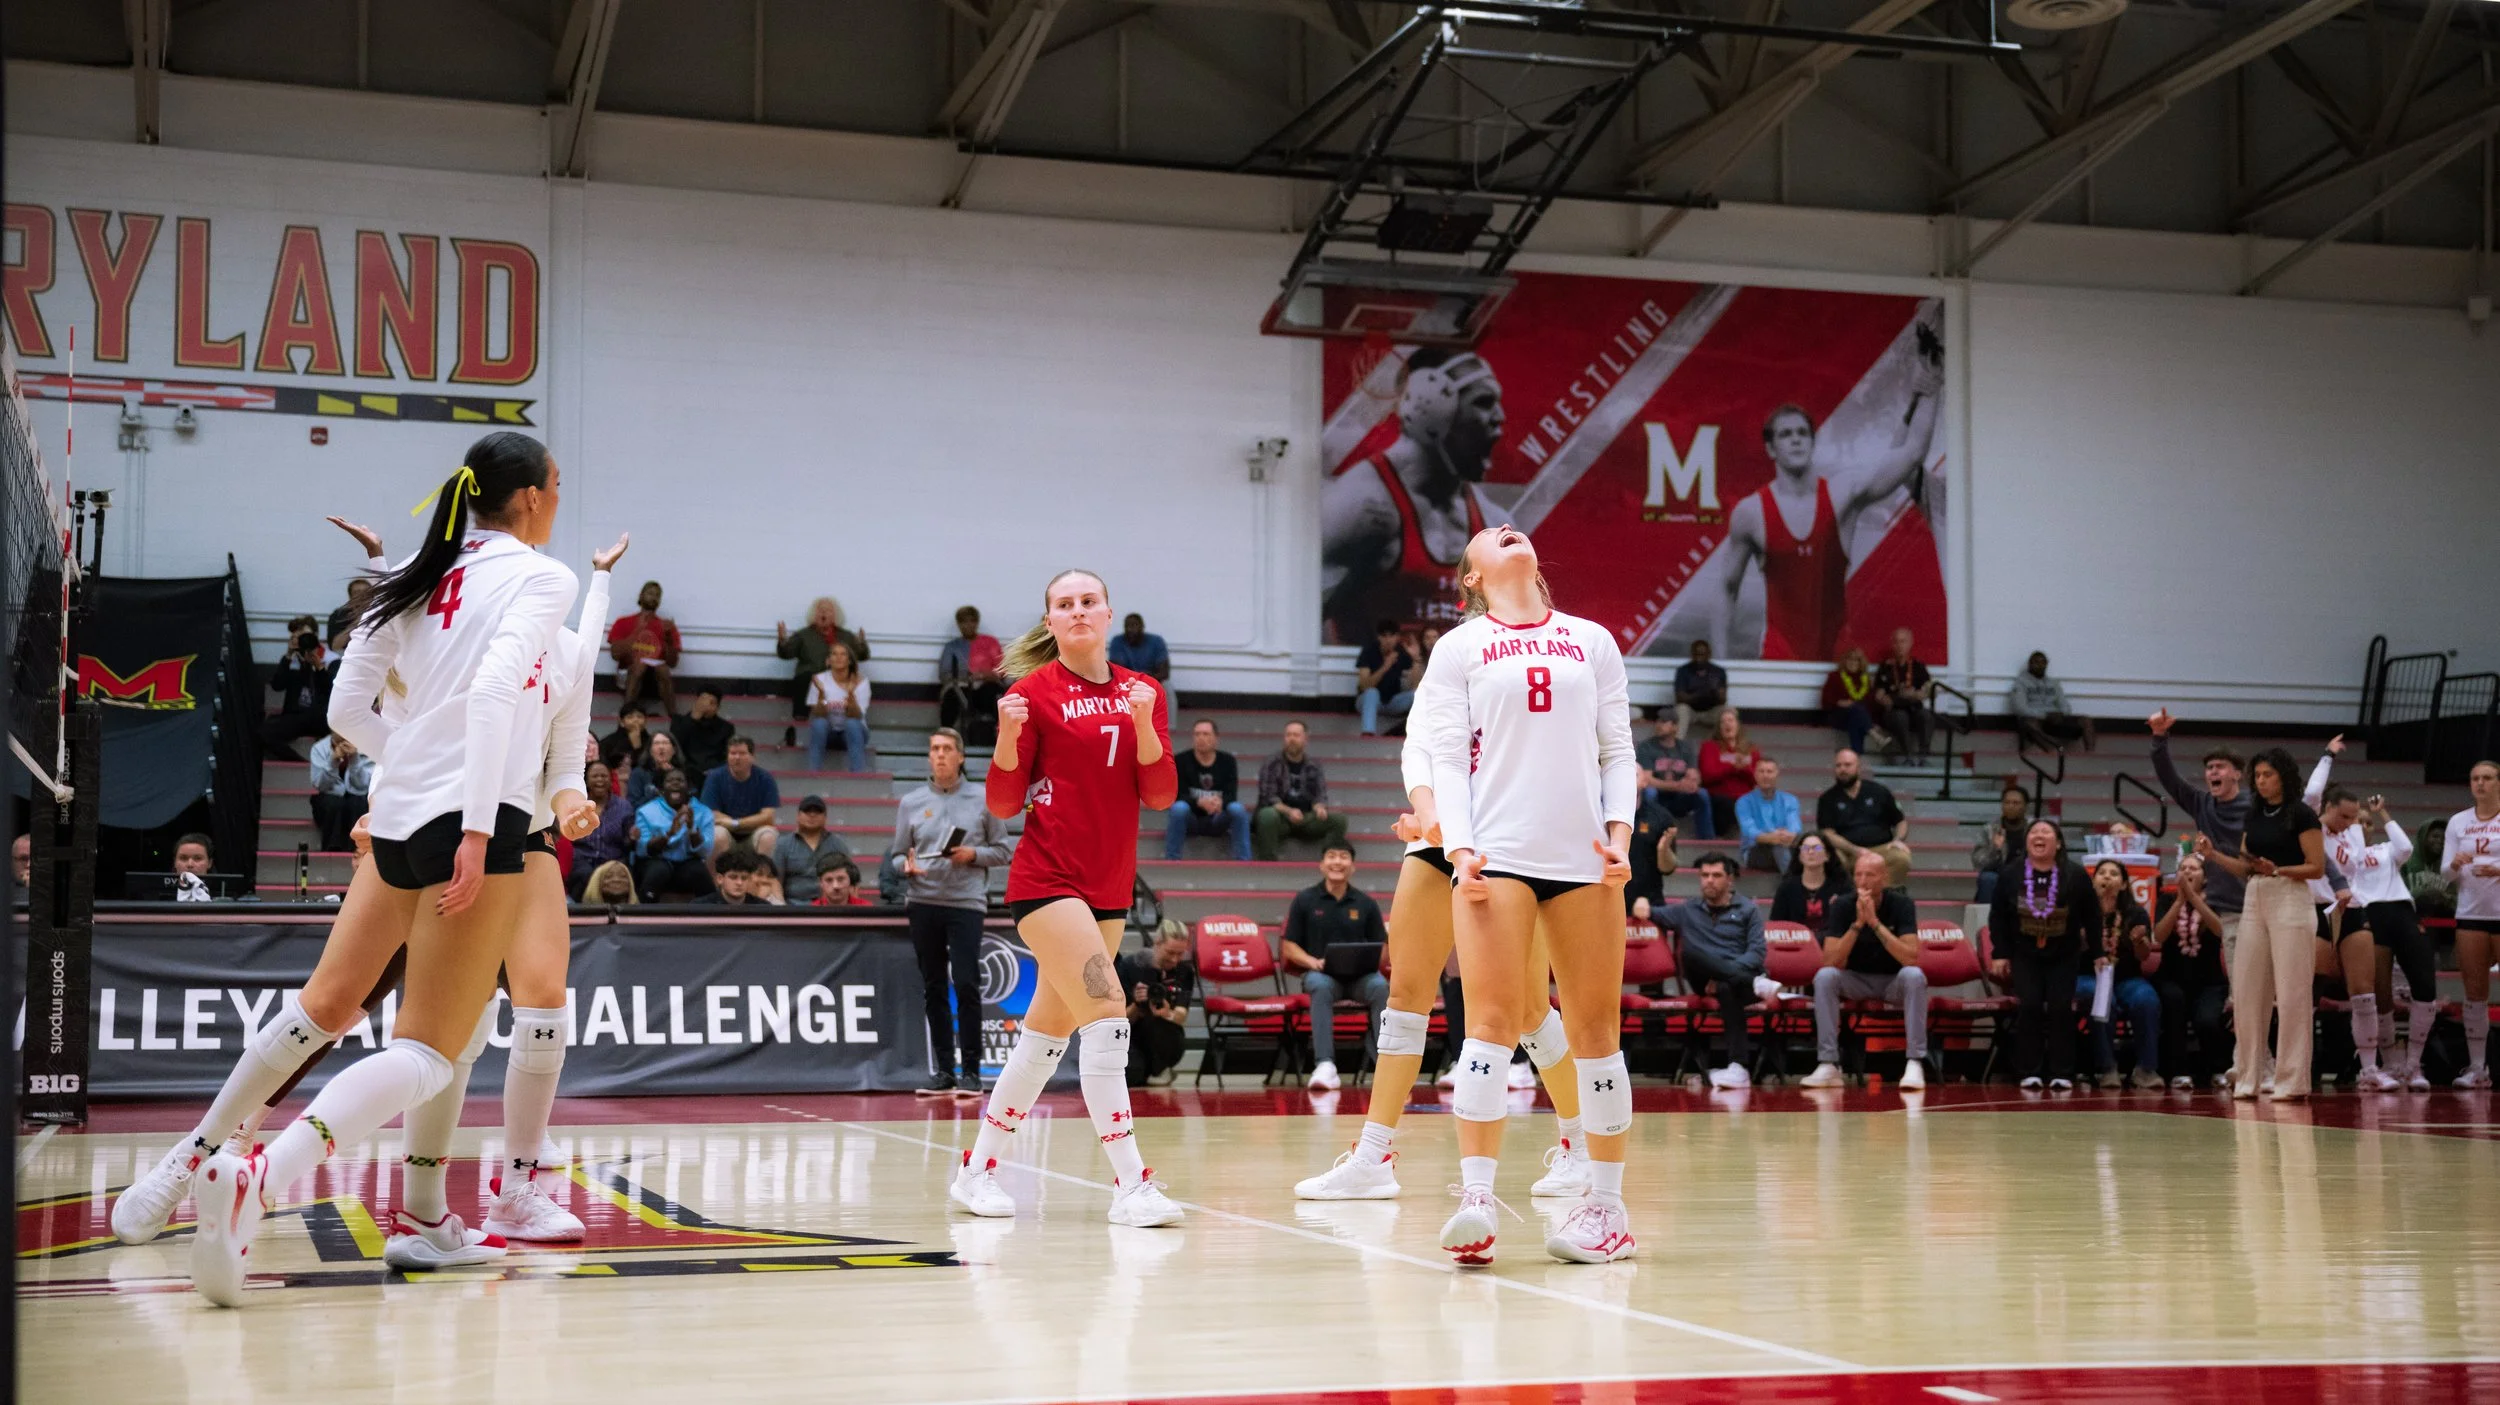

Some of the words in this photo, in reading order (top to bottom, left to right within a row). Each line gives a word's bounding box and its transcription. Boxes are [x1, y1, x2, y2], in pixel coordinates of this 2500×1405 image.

[1517, 298, 1669, 466] WRESTLING
[1642, 421, 1722, 510] M
[427, 566, 466, 630] 4
[1482, 638, 1585, 665] MARYLAND
[1061, 695, 1131, 723] MARYLAN
[1526, 667, 1552, 712] 8
[1100, 725, 1119, 767] 7
[2476, 838, 2490, 854] 12
[1204, 922, 1259, 937] MARYLAND
[1625, 926, 1659, 939] YLAND
[50, 951, 66, 996] sports
[48, 998, 64, 1054] imports
